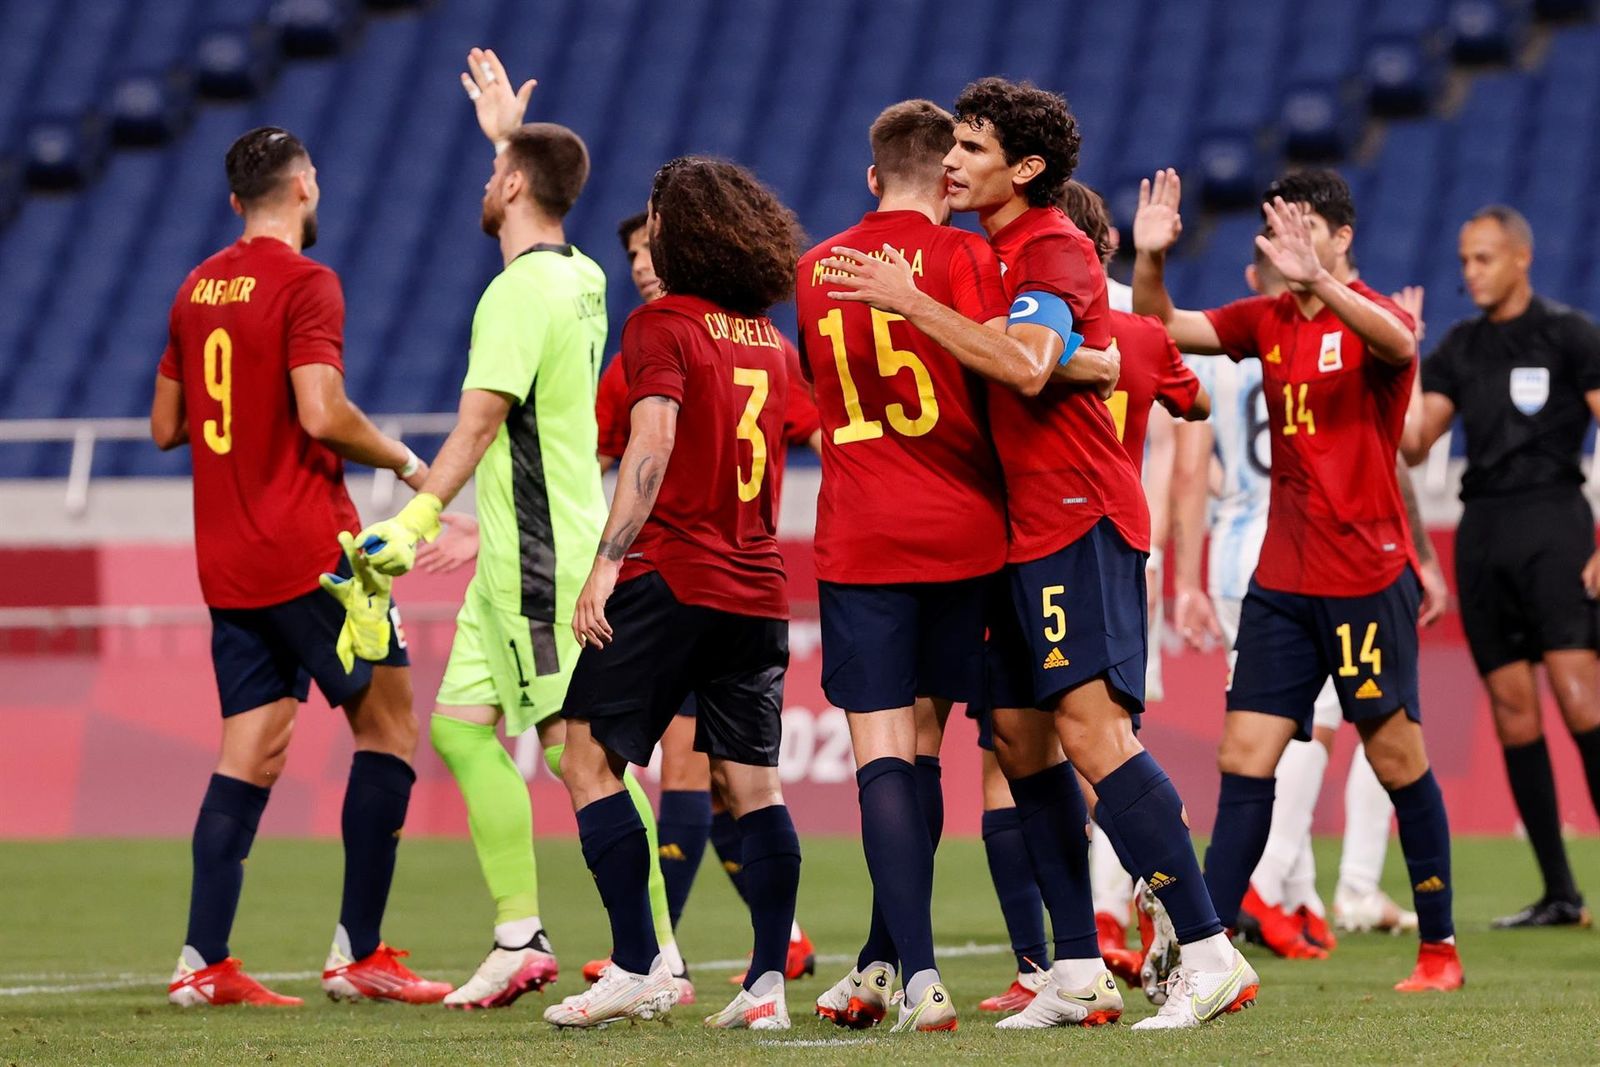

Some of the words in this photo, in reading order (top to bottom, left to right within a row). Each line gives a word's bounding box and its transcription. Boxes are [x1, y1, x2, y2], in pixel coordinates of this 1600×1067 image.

[204, 328, 232, 456] 9
[818, 307, 939, 445] 15
[734, 367, 769, 502] 3
[1282, 383, 1316, 436] 14
[1042, 585, 1067, 643] 5
[509, 638, 530, 688] 1
[1336, 622, 1382, 677] 14
